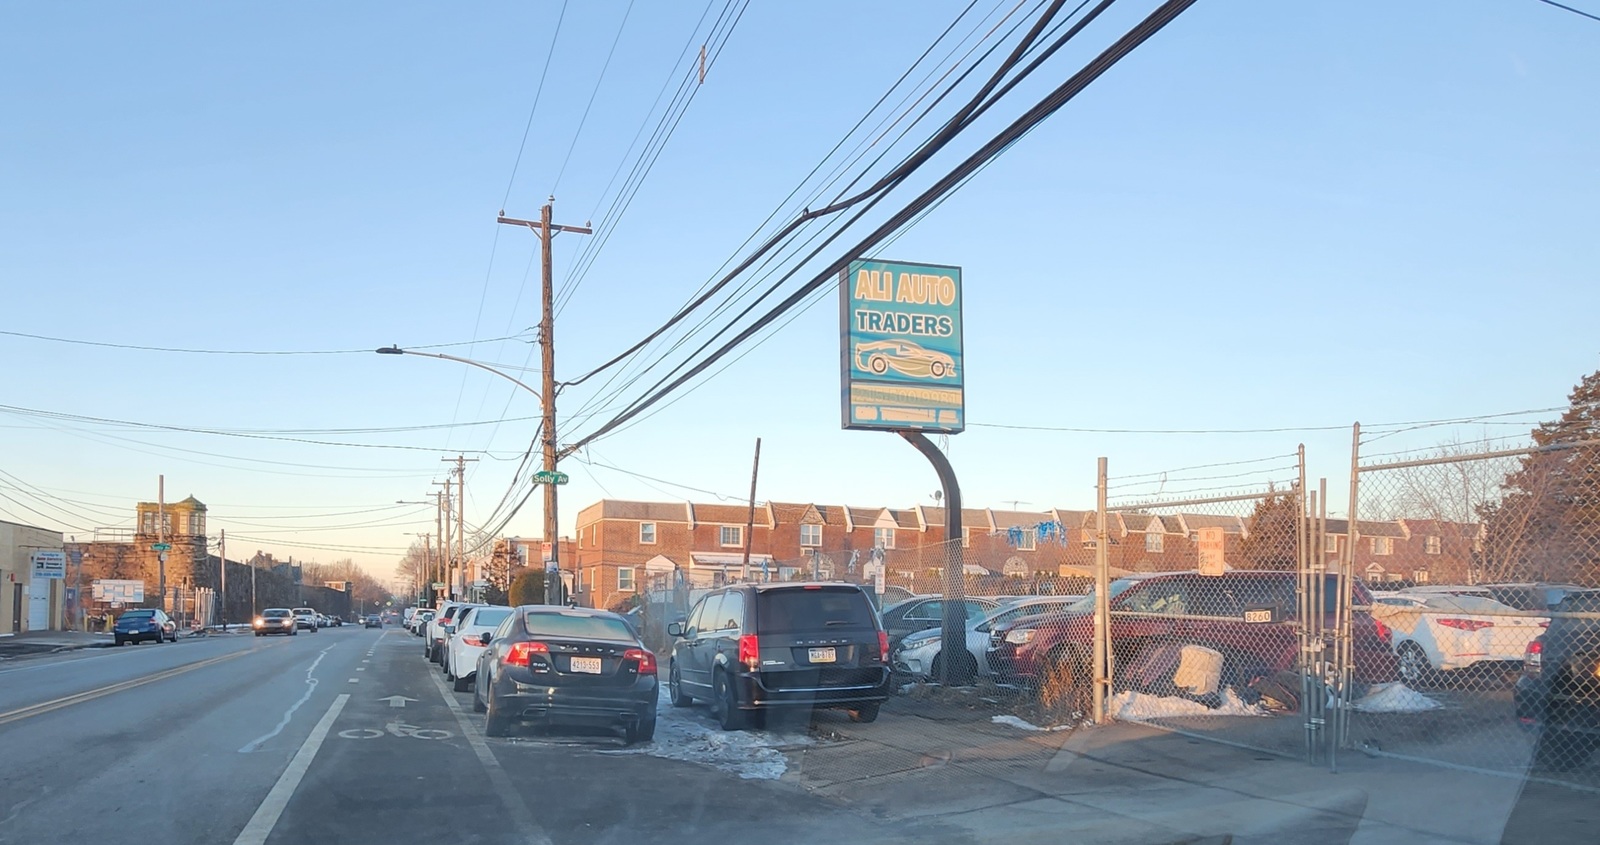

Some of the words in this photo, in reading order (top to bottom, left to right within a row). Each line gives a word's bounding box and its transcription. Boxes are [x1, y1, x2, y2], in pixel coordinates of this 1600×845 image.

[855, 270, 892, 302] ALI
[896, 273, 956, 306] AUTO
[855, 309, 953, 337] TRADERS
[534, 475, 554, 484] Solly
[1206, 531, 1215, 540] NO
[1246, 612, 1270, 622] 8260
